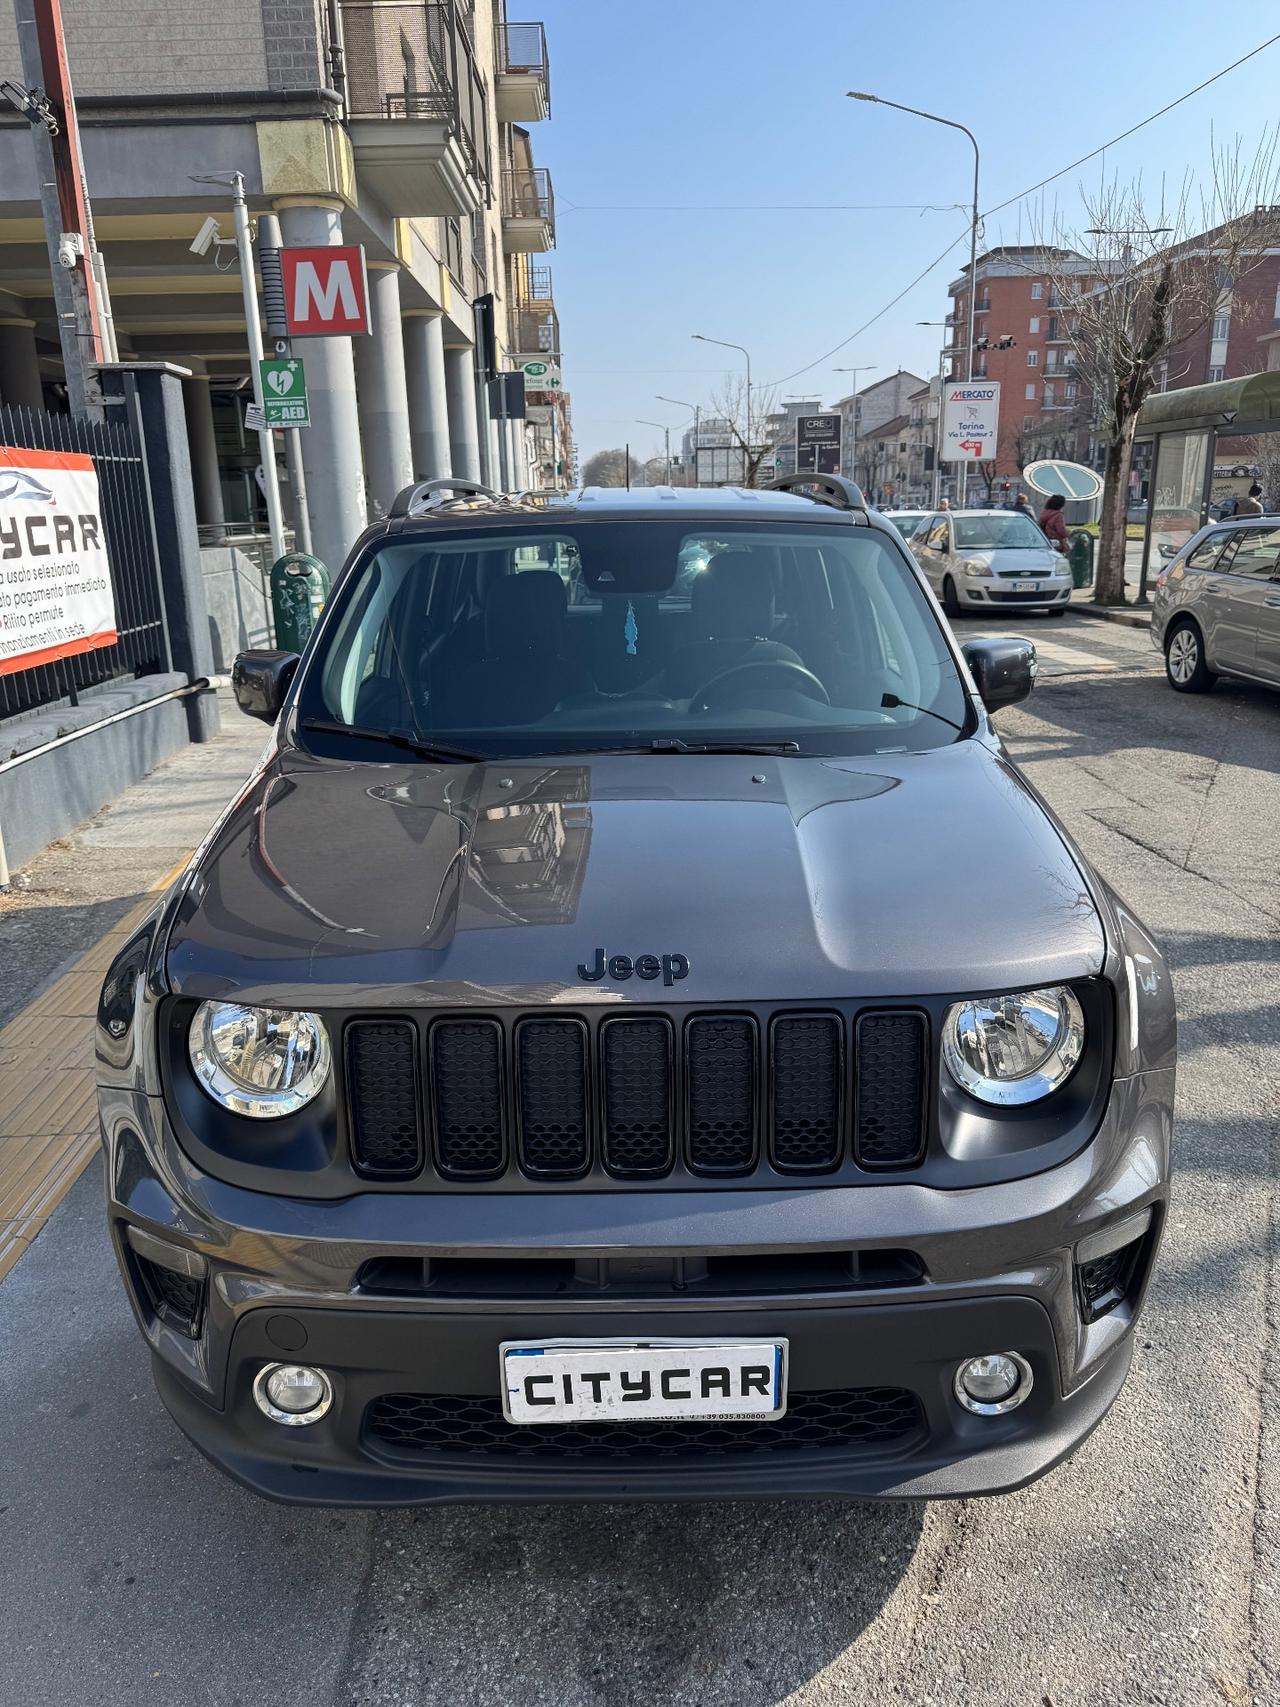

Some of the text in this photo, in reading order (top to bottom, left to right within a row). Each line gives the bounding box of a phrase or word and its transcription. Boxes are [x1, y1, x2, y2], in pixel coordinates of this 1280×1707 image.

[294, 260, 361, 322] M
[950, 389, 994, 400] MERCATO
[281, 406, 305, 419] AED
[958, 421, 985, 430] Torino
[7, 566, 32, 584] usato
[33, 562, 80, 580] selezionato
[14, 584, 64, 609] pagamento
[65, 577, 107, 596] immediato
[3, 605, 64, 630] Ritiro permute
[57, 627, 66, 640] in
[65, 621, 86, 637] sede
[577, 948, 690, 987] Jeep
[523, 1365, 771, 1406] CITYCAR
